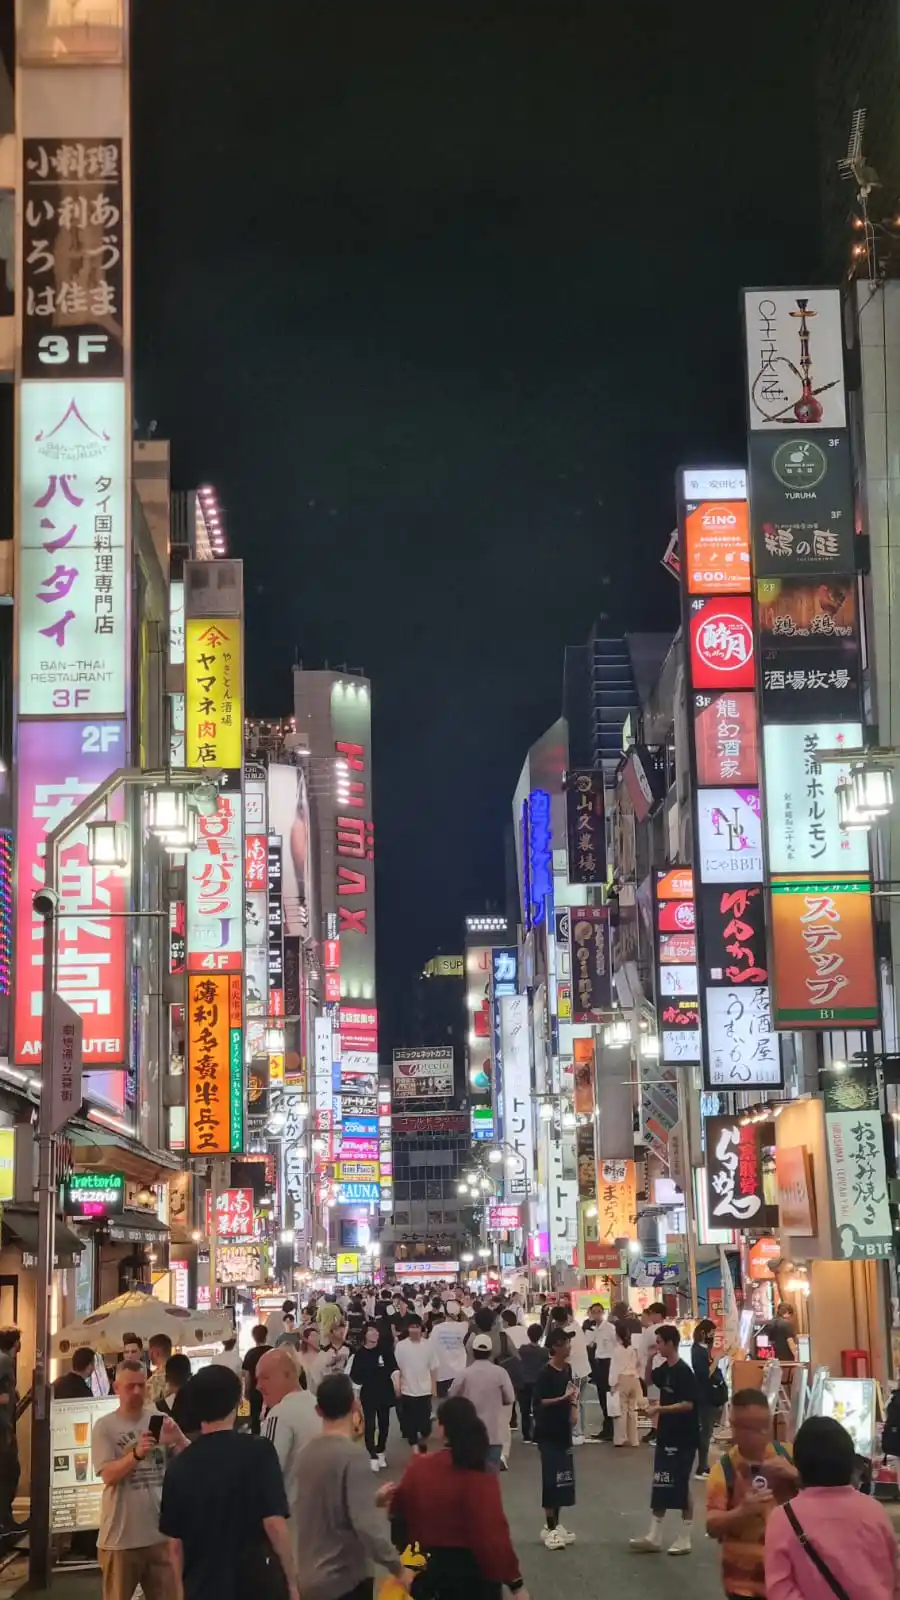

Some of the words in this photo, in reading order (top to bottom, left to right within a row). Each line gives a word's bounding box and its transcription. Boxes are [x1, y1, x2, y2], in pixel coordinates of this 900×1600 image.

[27, 143, 118, 179] 小料理
[26, 199, 55, 316] いろは
[38, 336, 109, 364] 3F
[785, 491, 817, 500] YURUHA
[702, 515, 737, 526] ZINO
[33, 473, 83, 648] バンタイ
[94, 475, 114, 635] タイ国料理専門店
[691, 599, 705, 611] 4F
[40, 661, 106, 671] BAN-THAI
[30, 672, 112, 683] RESTAURANT
[764, 668, 850, 691] 酒場牧場
[53, 689, 91, 708] 3F
[195, 653, 217, 762] ヤマネ肉店
[695, 695, 712, 707] 3F
[82, 726, 121, 753] 2F
[799, 894, 850, 1005] ステップ
[202, 953, 229, 969] 4F
[866, 1243, 893, 1256] B1F
